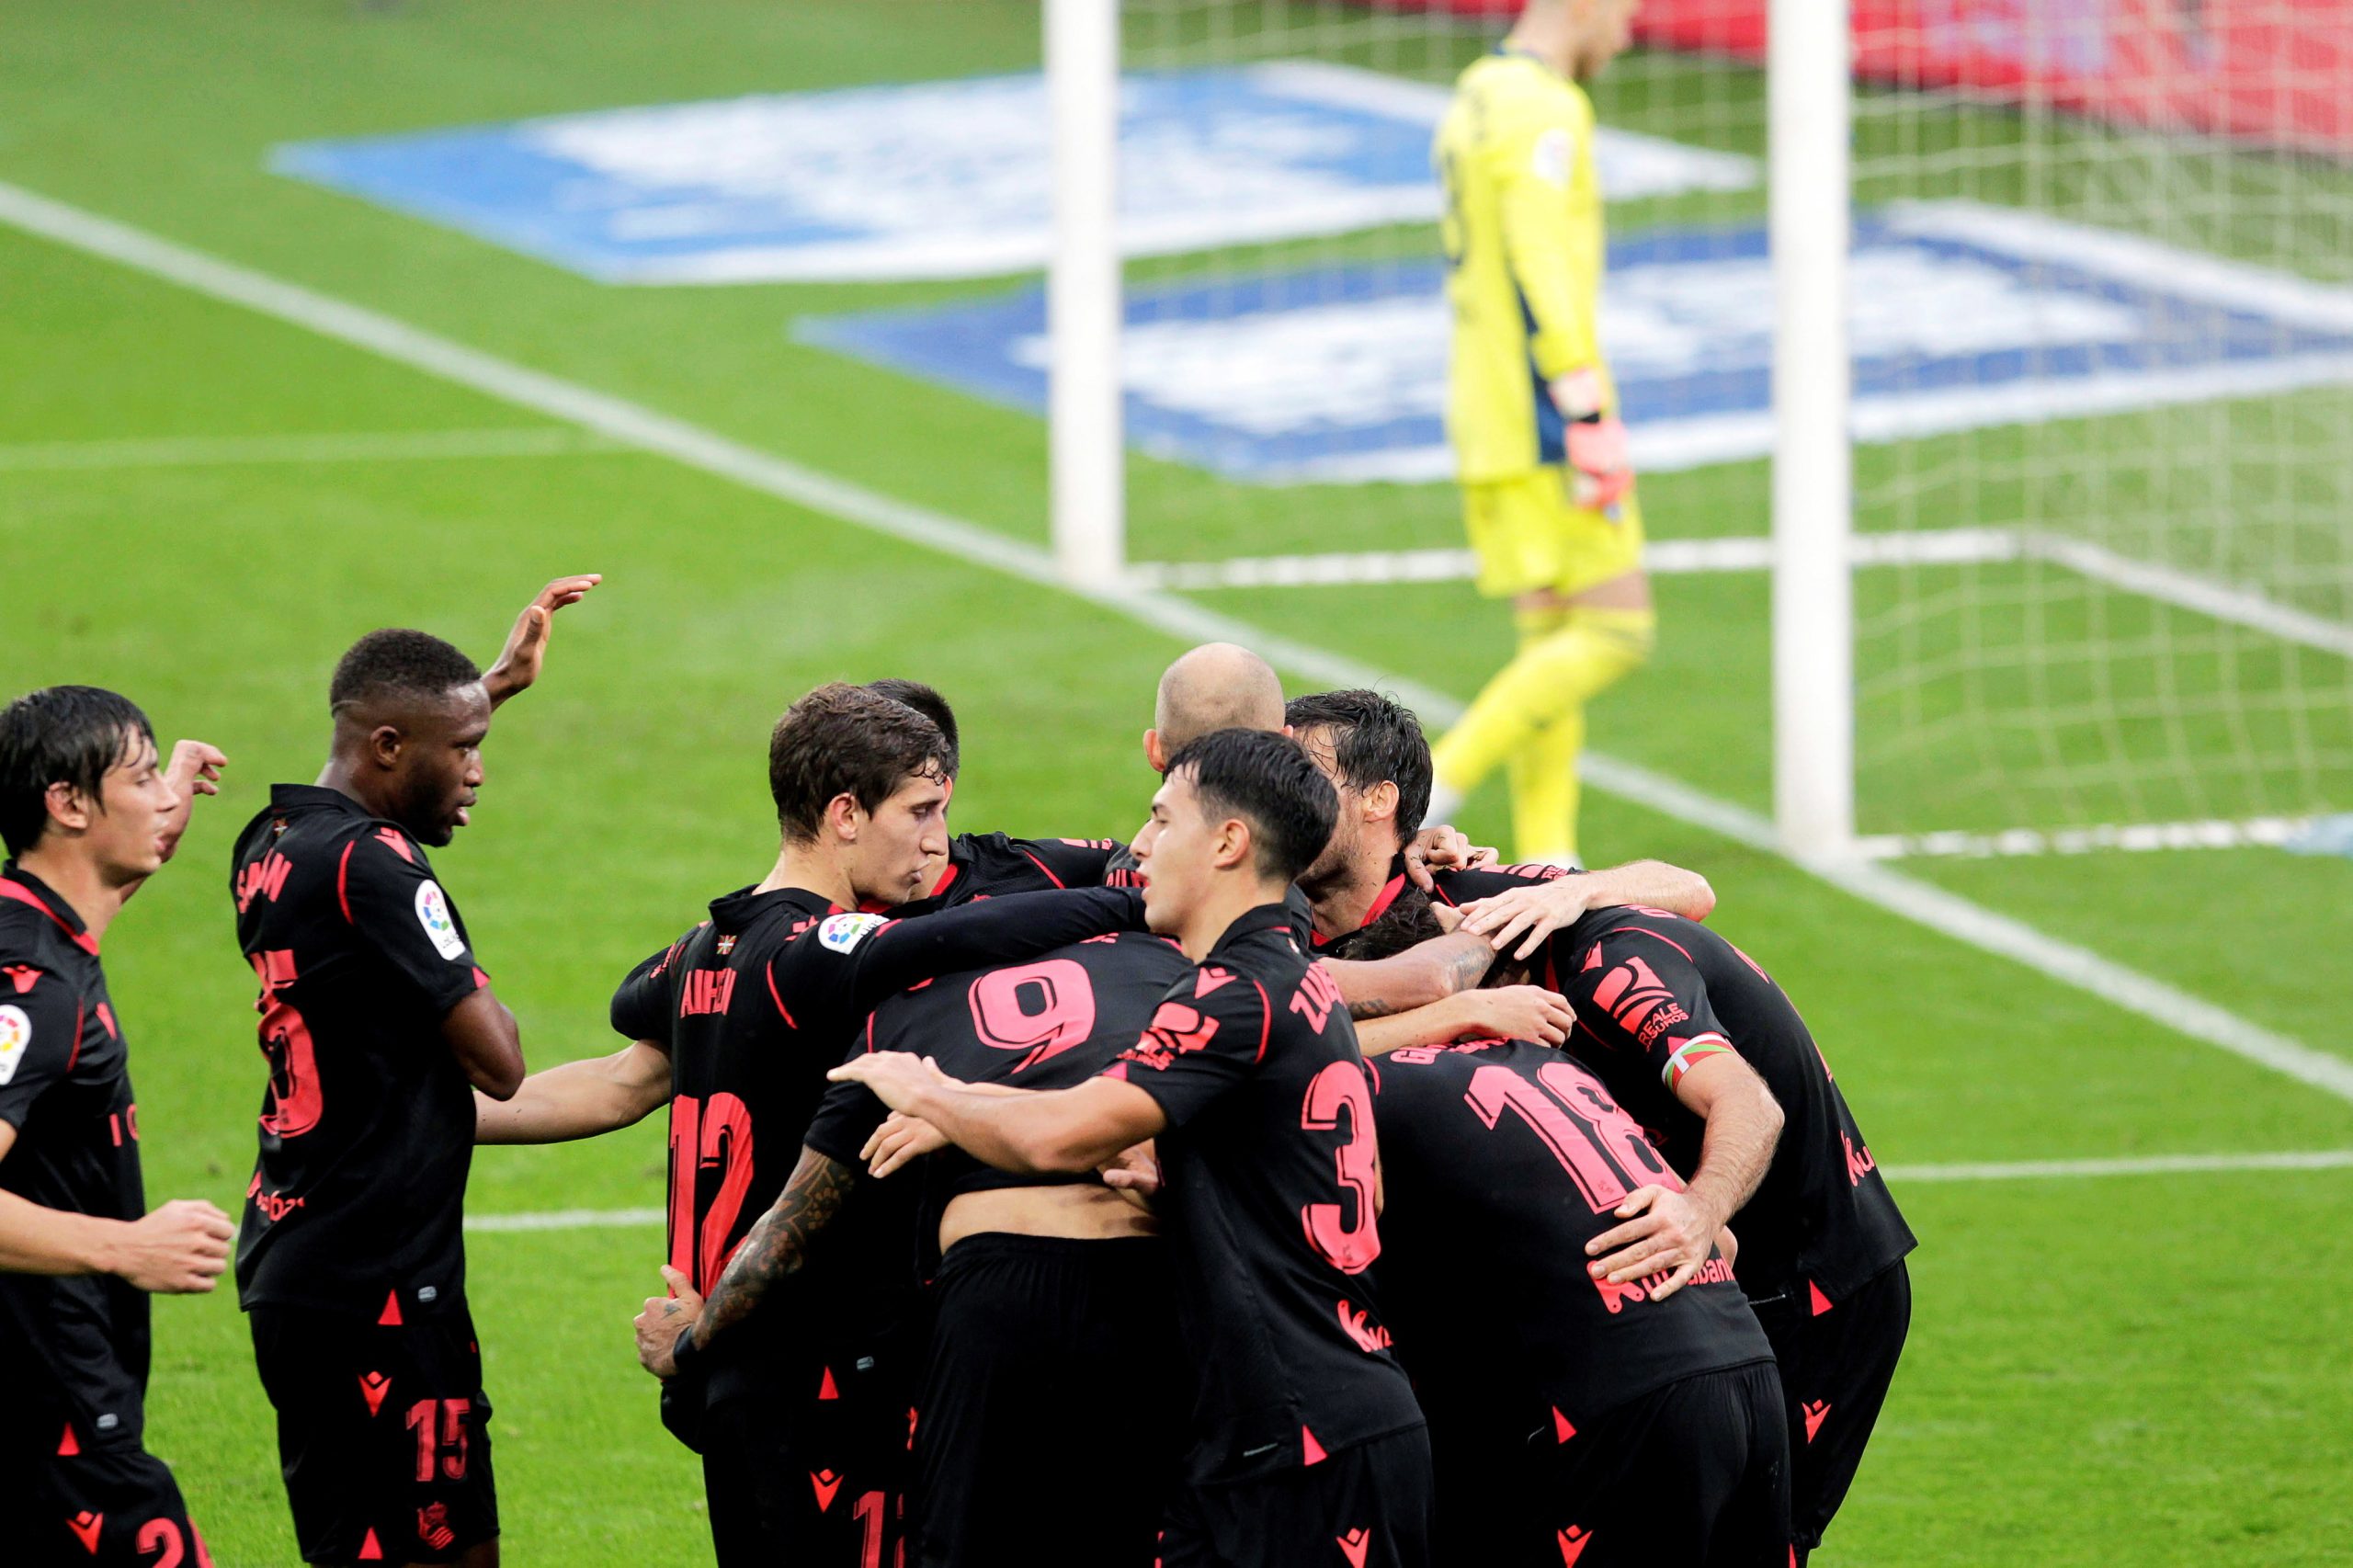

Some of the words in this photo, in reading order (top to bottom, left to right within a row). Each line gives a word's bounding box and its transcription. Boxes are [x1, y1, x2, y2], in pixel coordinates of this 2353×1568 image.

[968, 959, 1096, 1074] 9
[1638, 1002, 1683, 1047] REALE
[1301, 1060, 1381, 1276] 3
[1463, 1062, 1682, 1215] 18
[666, 1092, 756, 1301] 12
[405, 1398, 471, 1482] 15
[853, 1490, 905, 1568] 1
